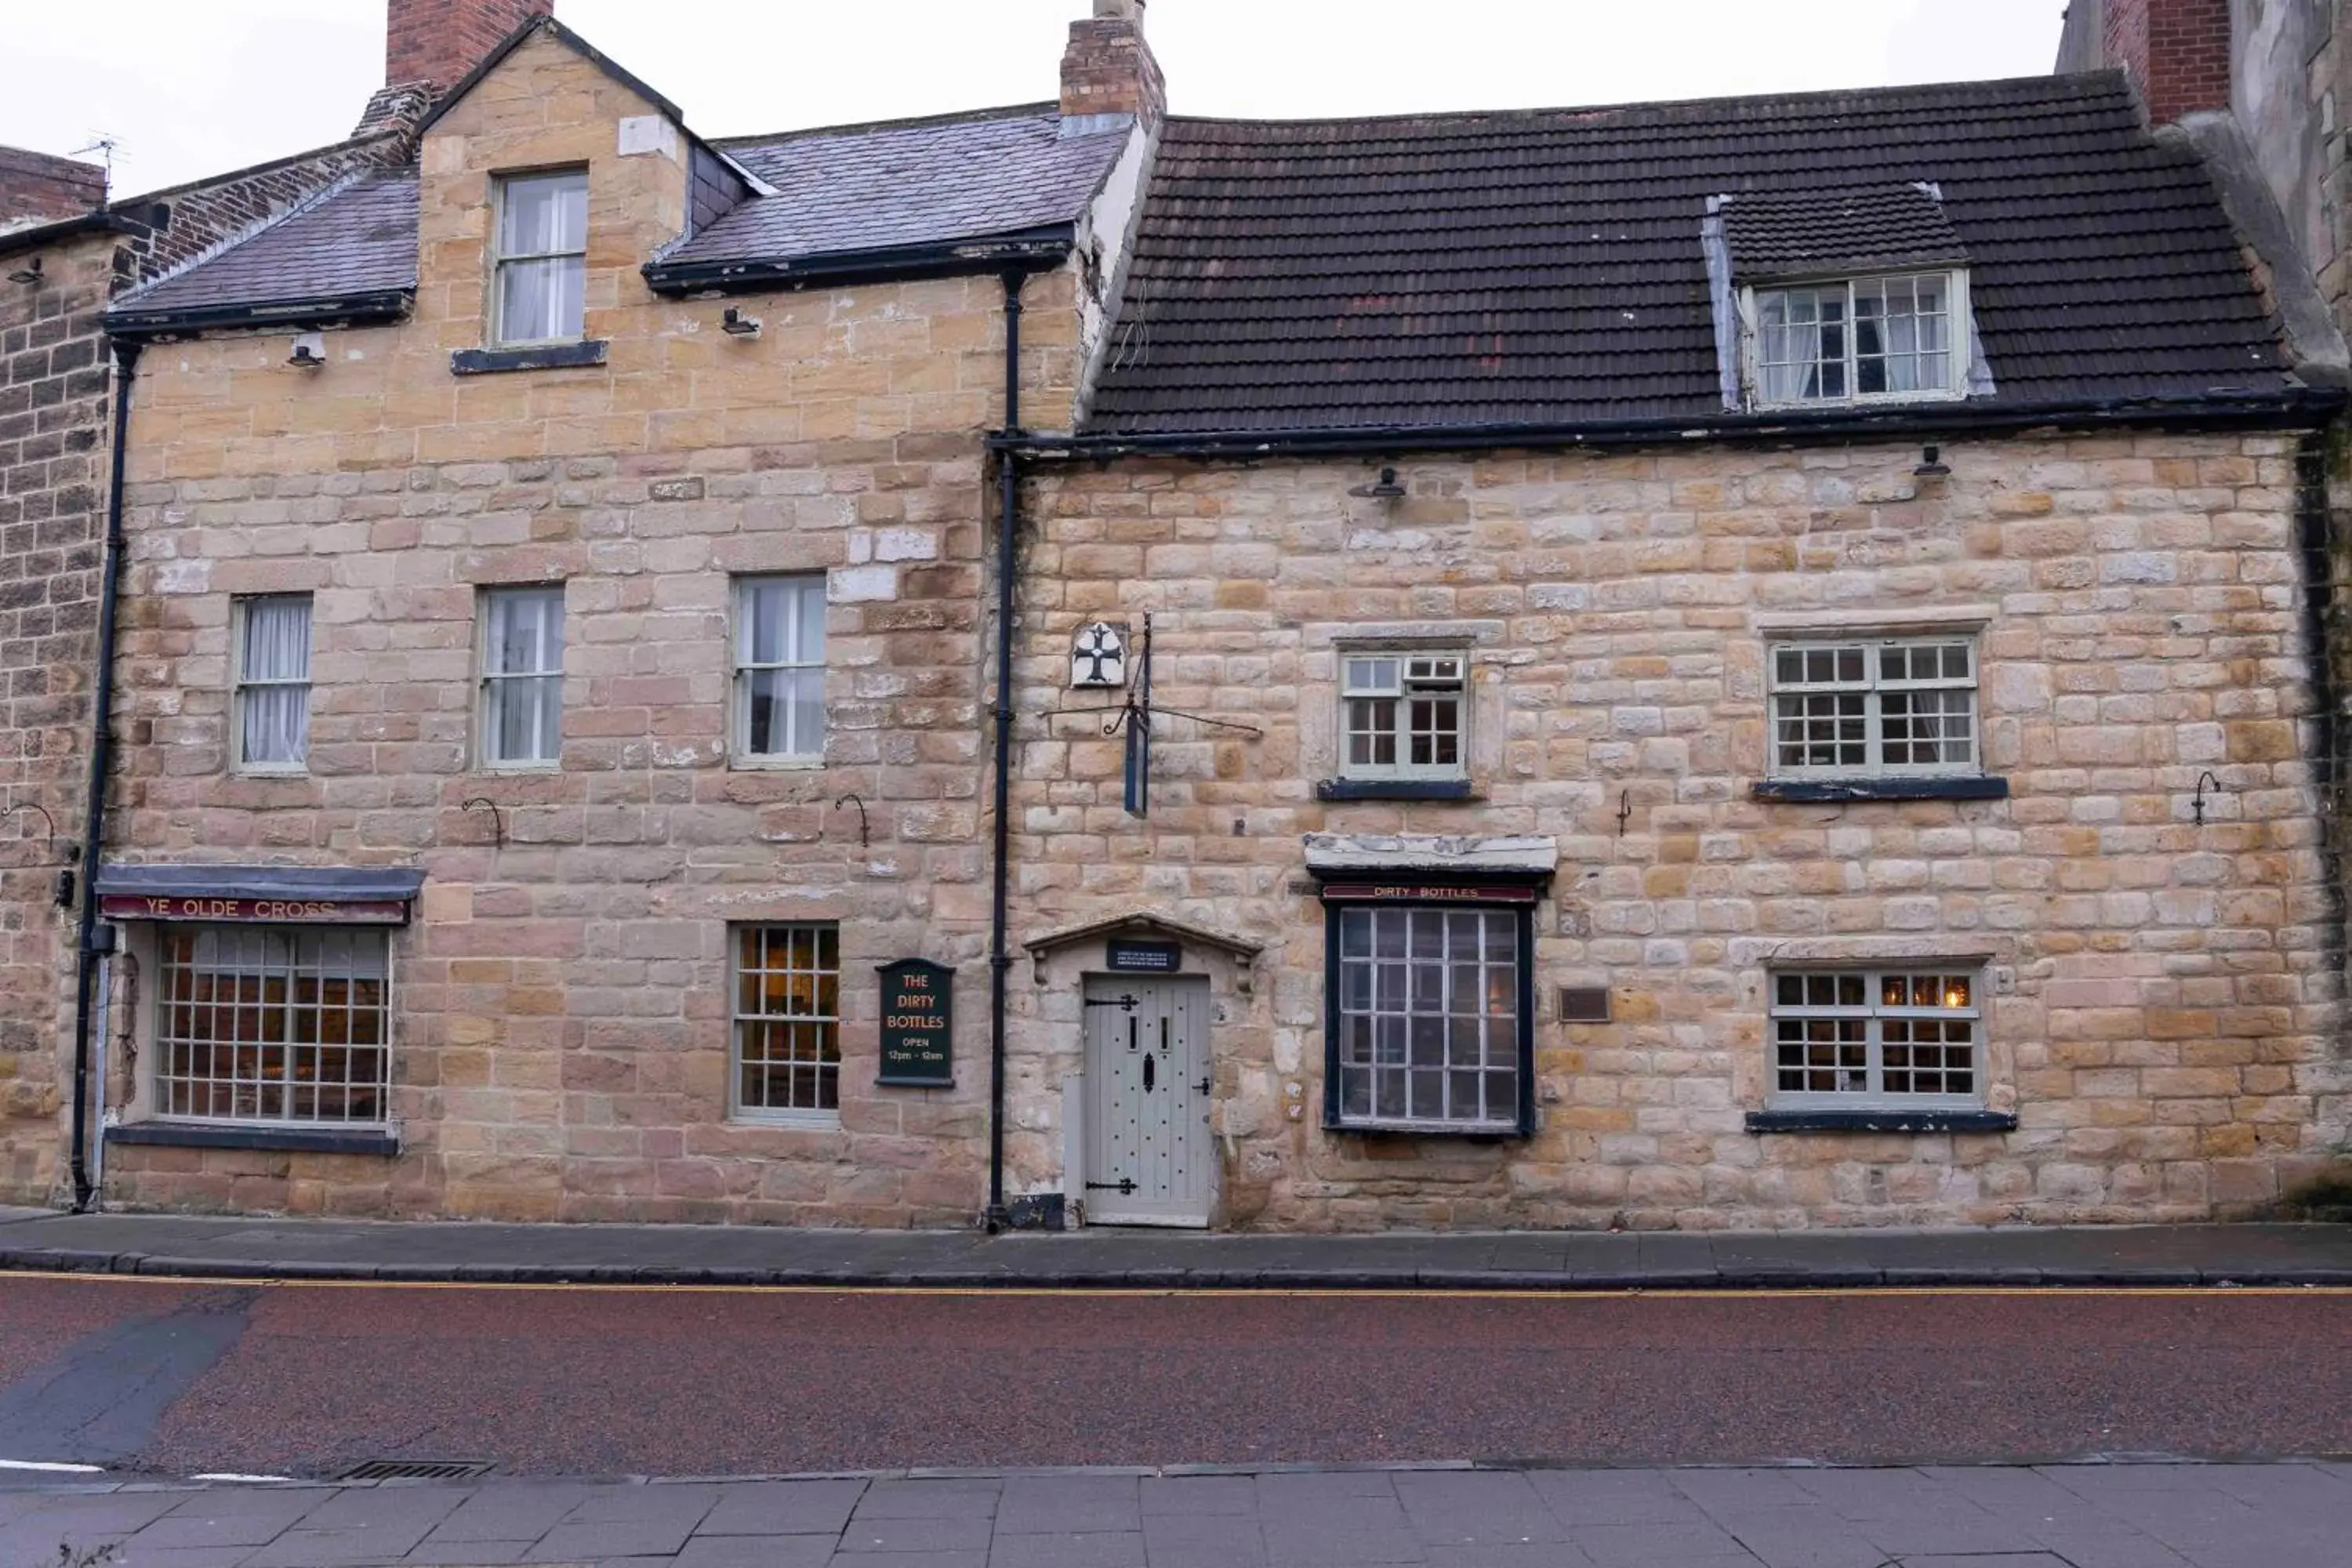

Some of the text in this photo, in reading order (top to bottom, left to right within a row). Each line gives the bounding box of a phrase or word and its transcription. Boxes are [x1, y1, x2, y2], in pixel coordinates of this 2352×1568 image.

[1374, 887, 1479, 898] DIRTY BOTTLES
[147, 898, 336, 920] YE OLDE CROSS
[903, 975, 929, 988] THE
[897, 995, 936, 1008] DIRTY
[887, 1015, 945, 1029] BOTTLES
[902, 1037, 929, 1047] OPEN
